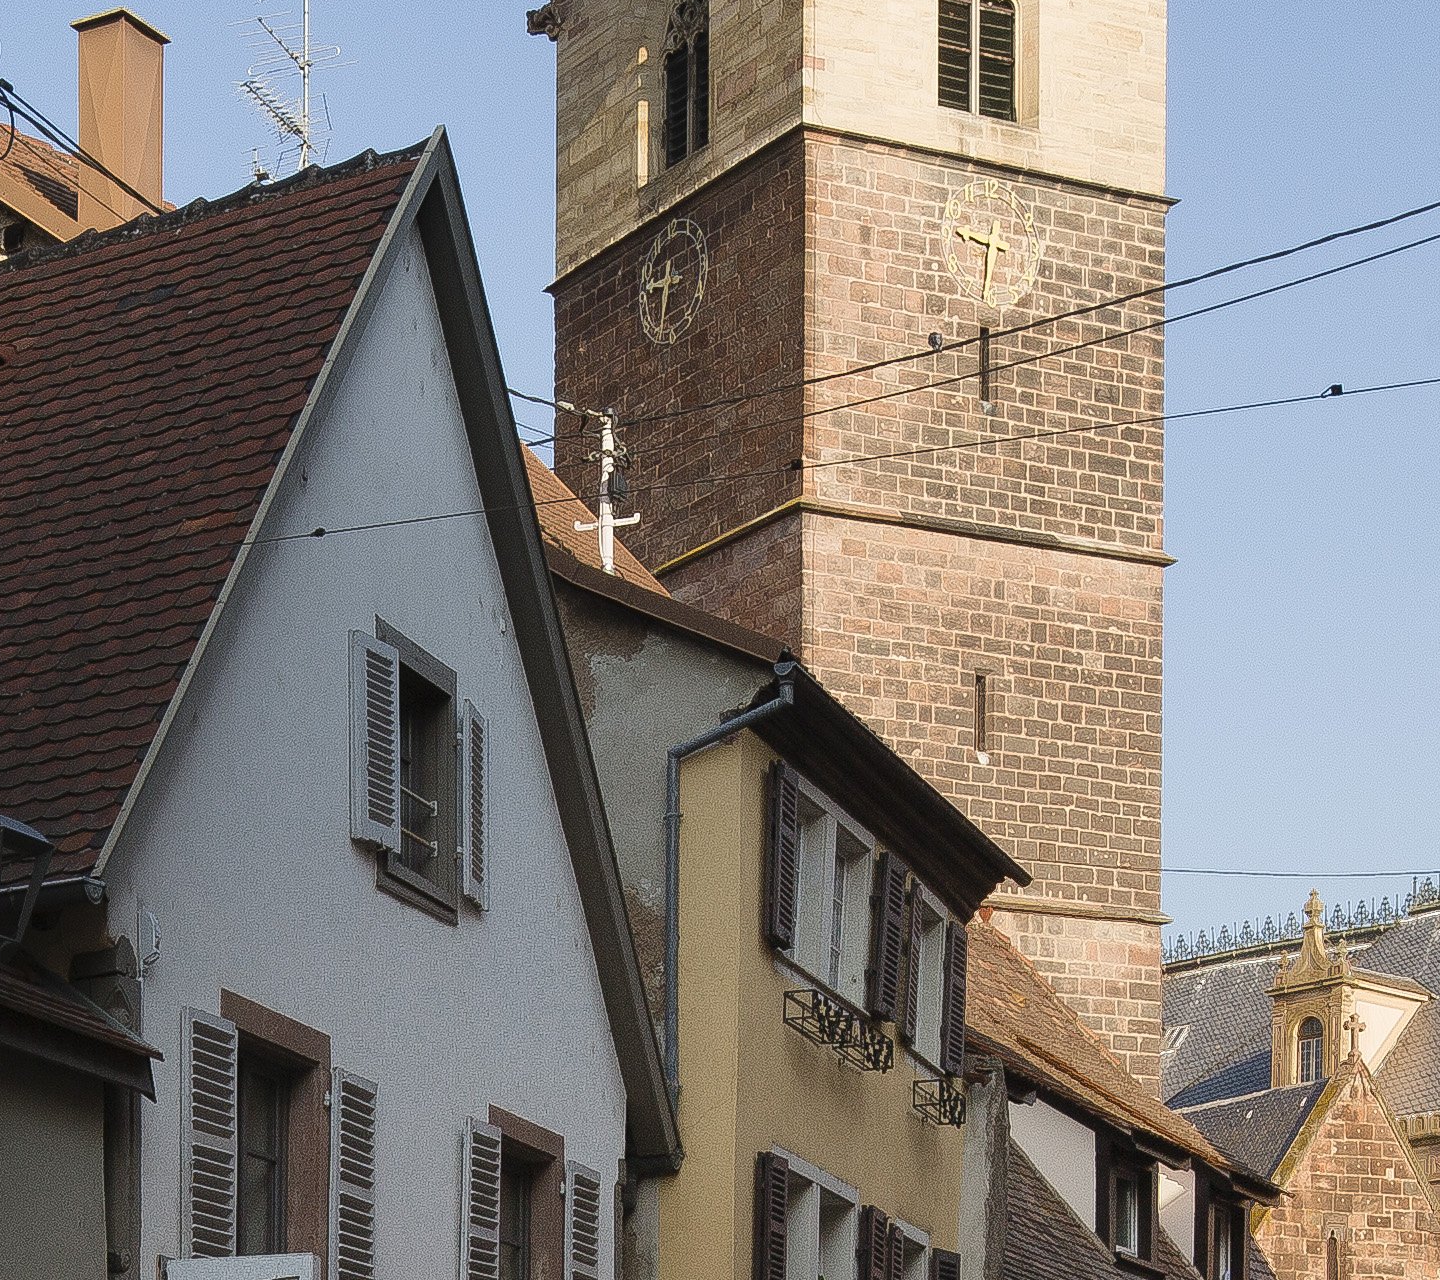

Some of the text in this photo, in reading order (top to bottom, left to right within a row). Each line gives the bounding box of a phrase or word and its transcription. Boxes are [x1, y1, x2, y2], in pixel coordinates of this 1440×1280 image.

[965, 184, 974, 203] 11
[985, 180, 998, 198] 12
[946, 199, 960, 219] 10
[667, 218, 677, 239] 12
[1025, 212, 1033, 233] 2
[1031, 240, 1039, 261] 3
[948, 254, 957, 273] 8
